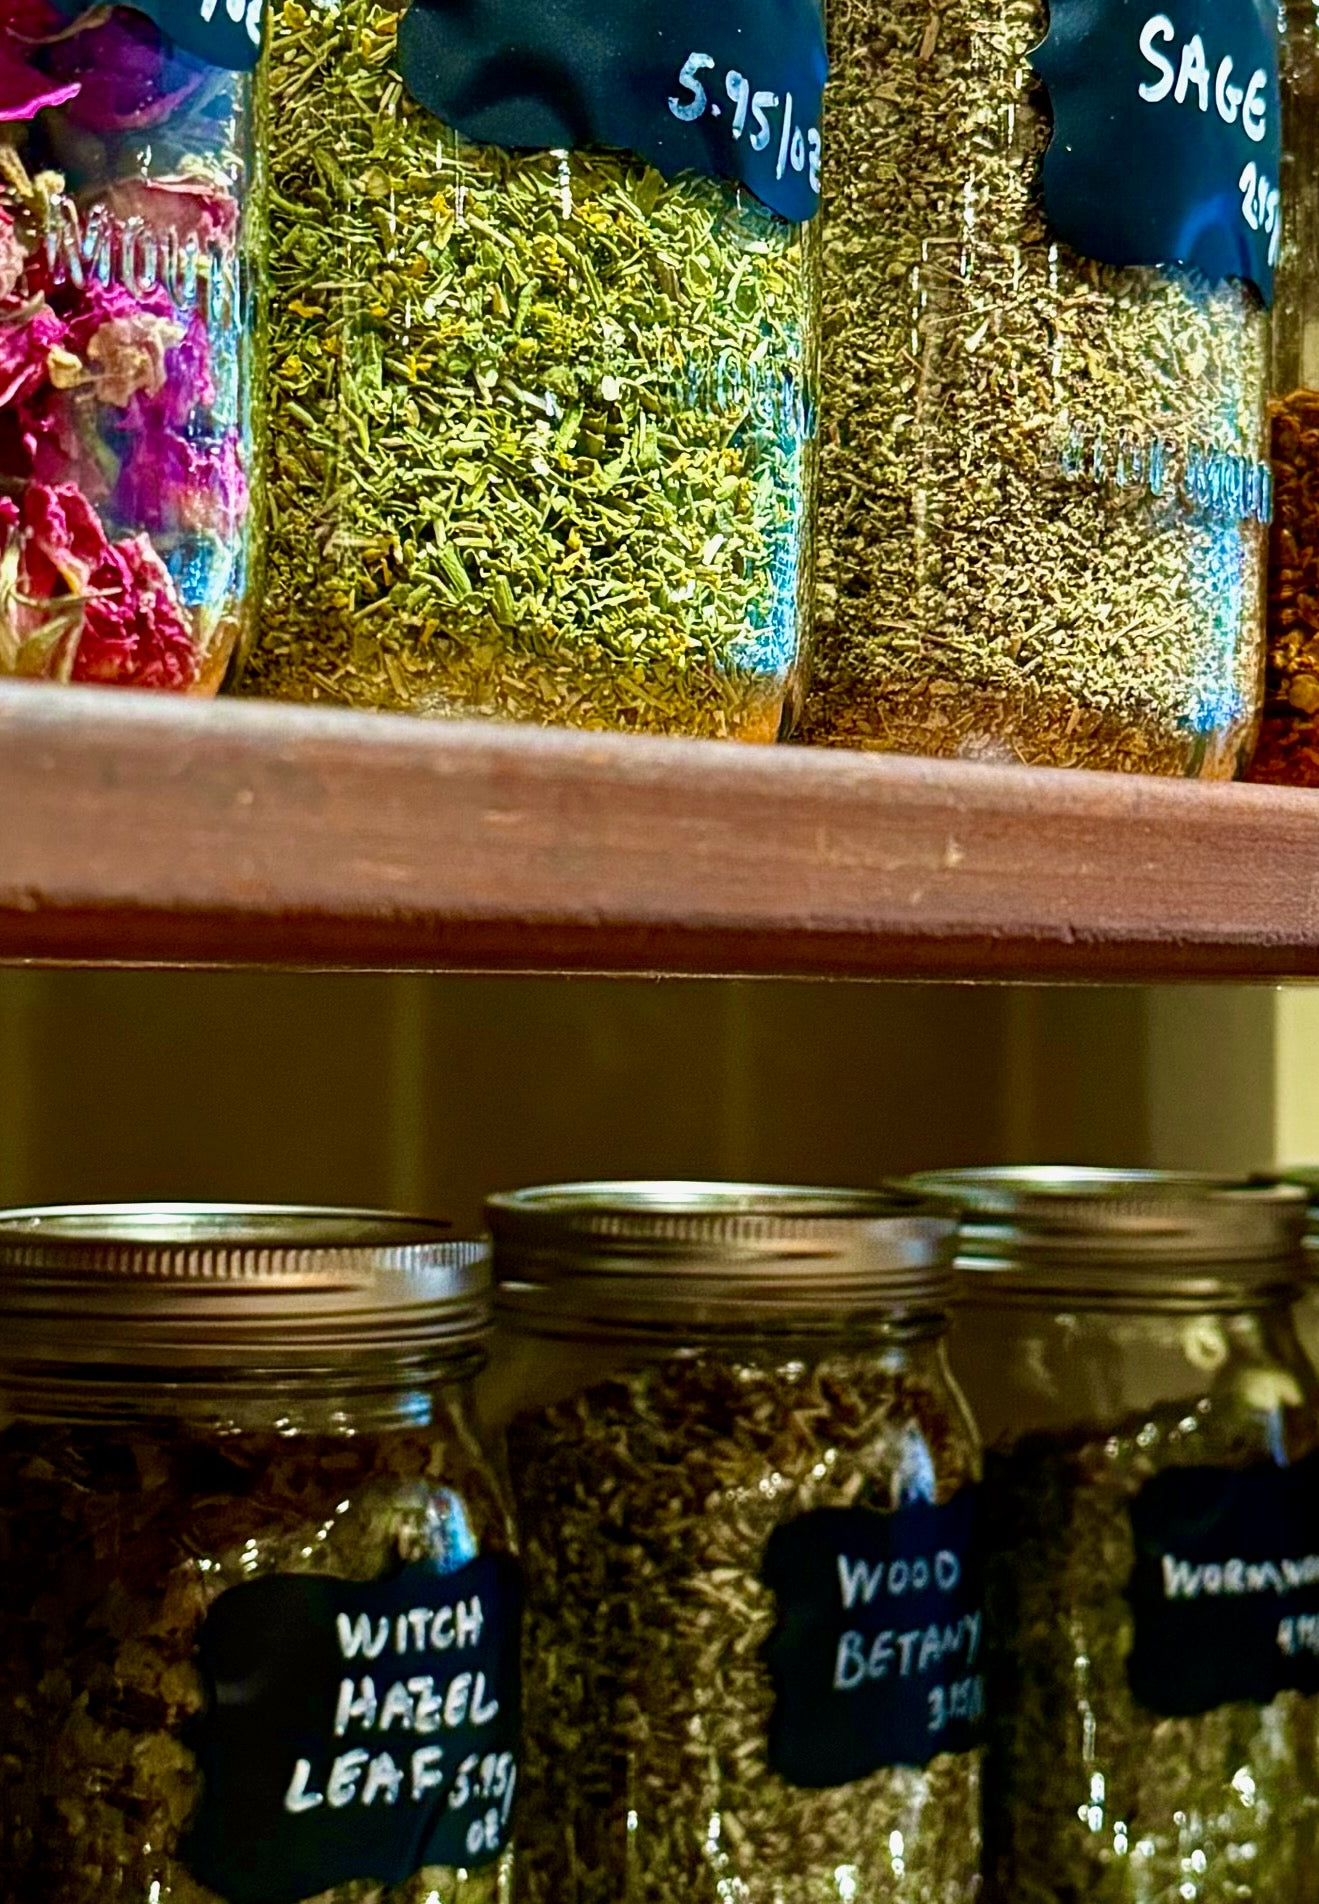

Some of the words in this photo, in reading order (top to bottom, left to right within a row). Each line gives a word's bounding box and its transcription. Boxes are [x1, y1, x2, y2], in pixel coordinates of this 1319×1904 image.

[1139, 14, 1267, 141] SAGE
[837, 1549, 960, 1609] WOOD
[336, 1596, 483, 1658] WITCH
[335, 1671, 499, 1737] HAZEL
[285, 1746, 443, 1813] LEAF
